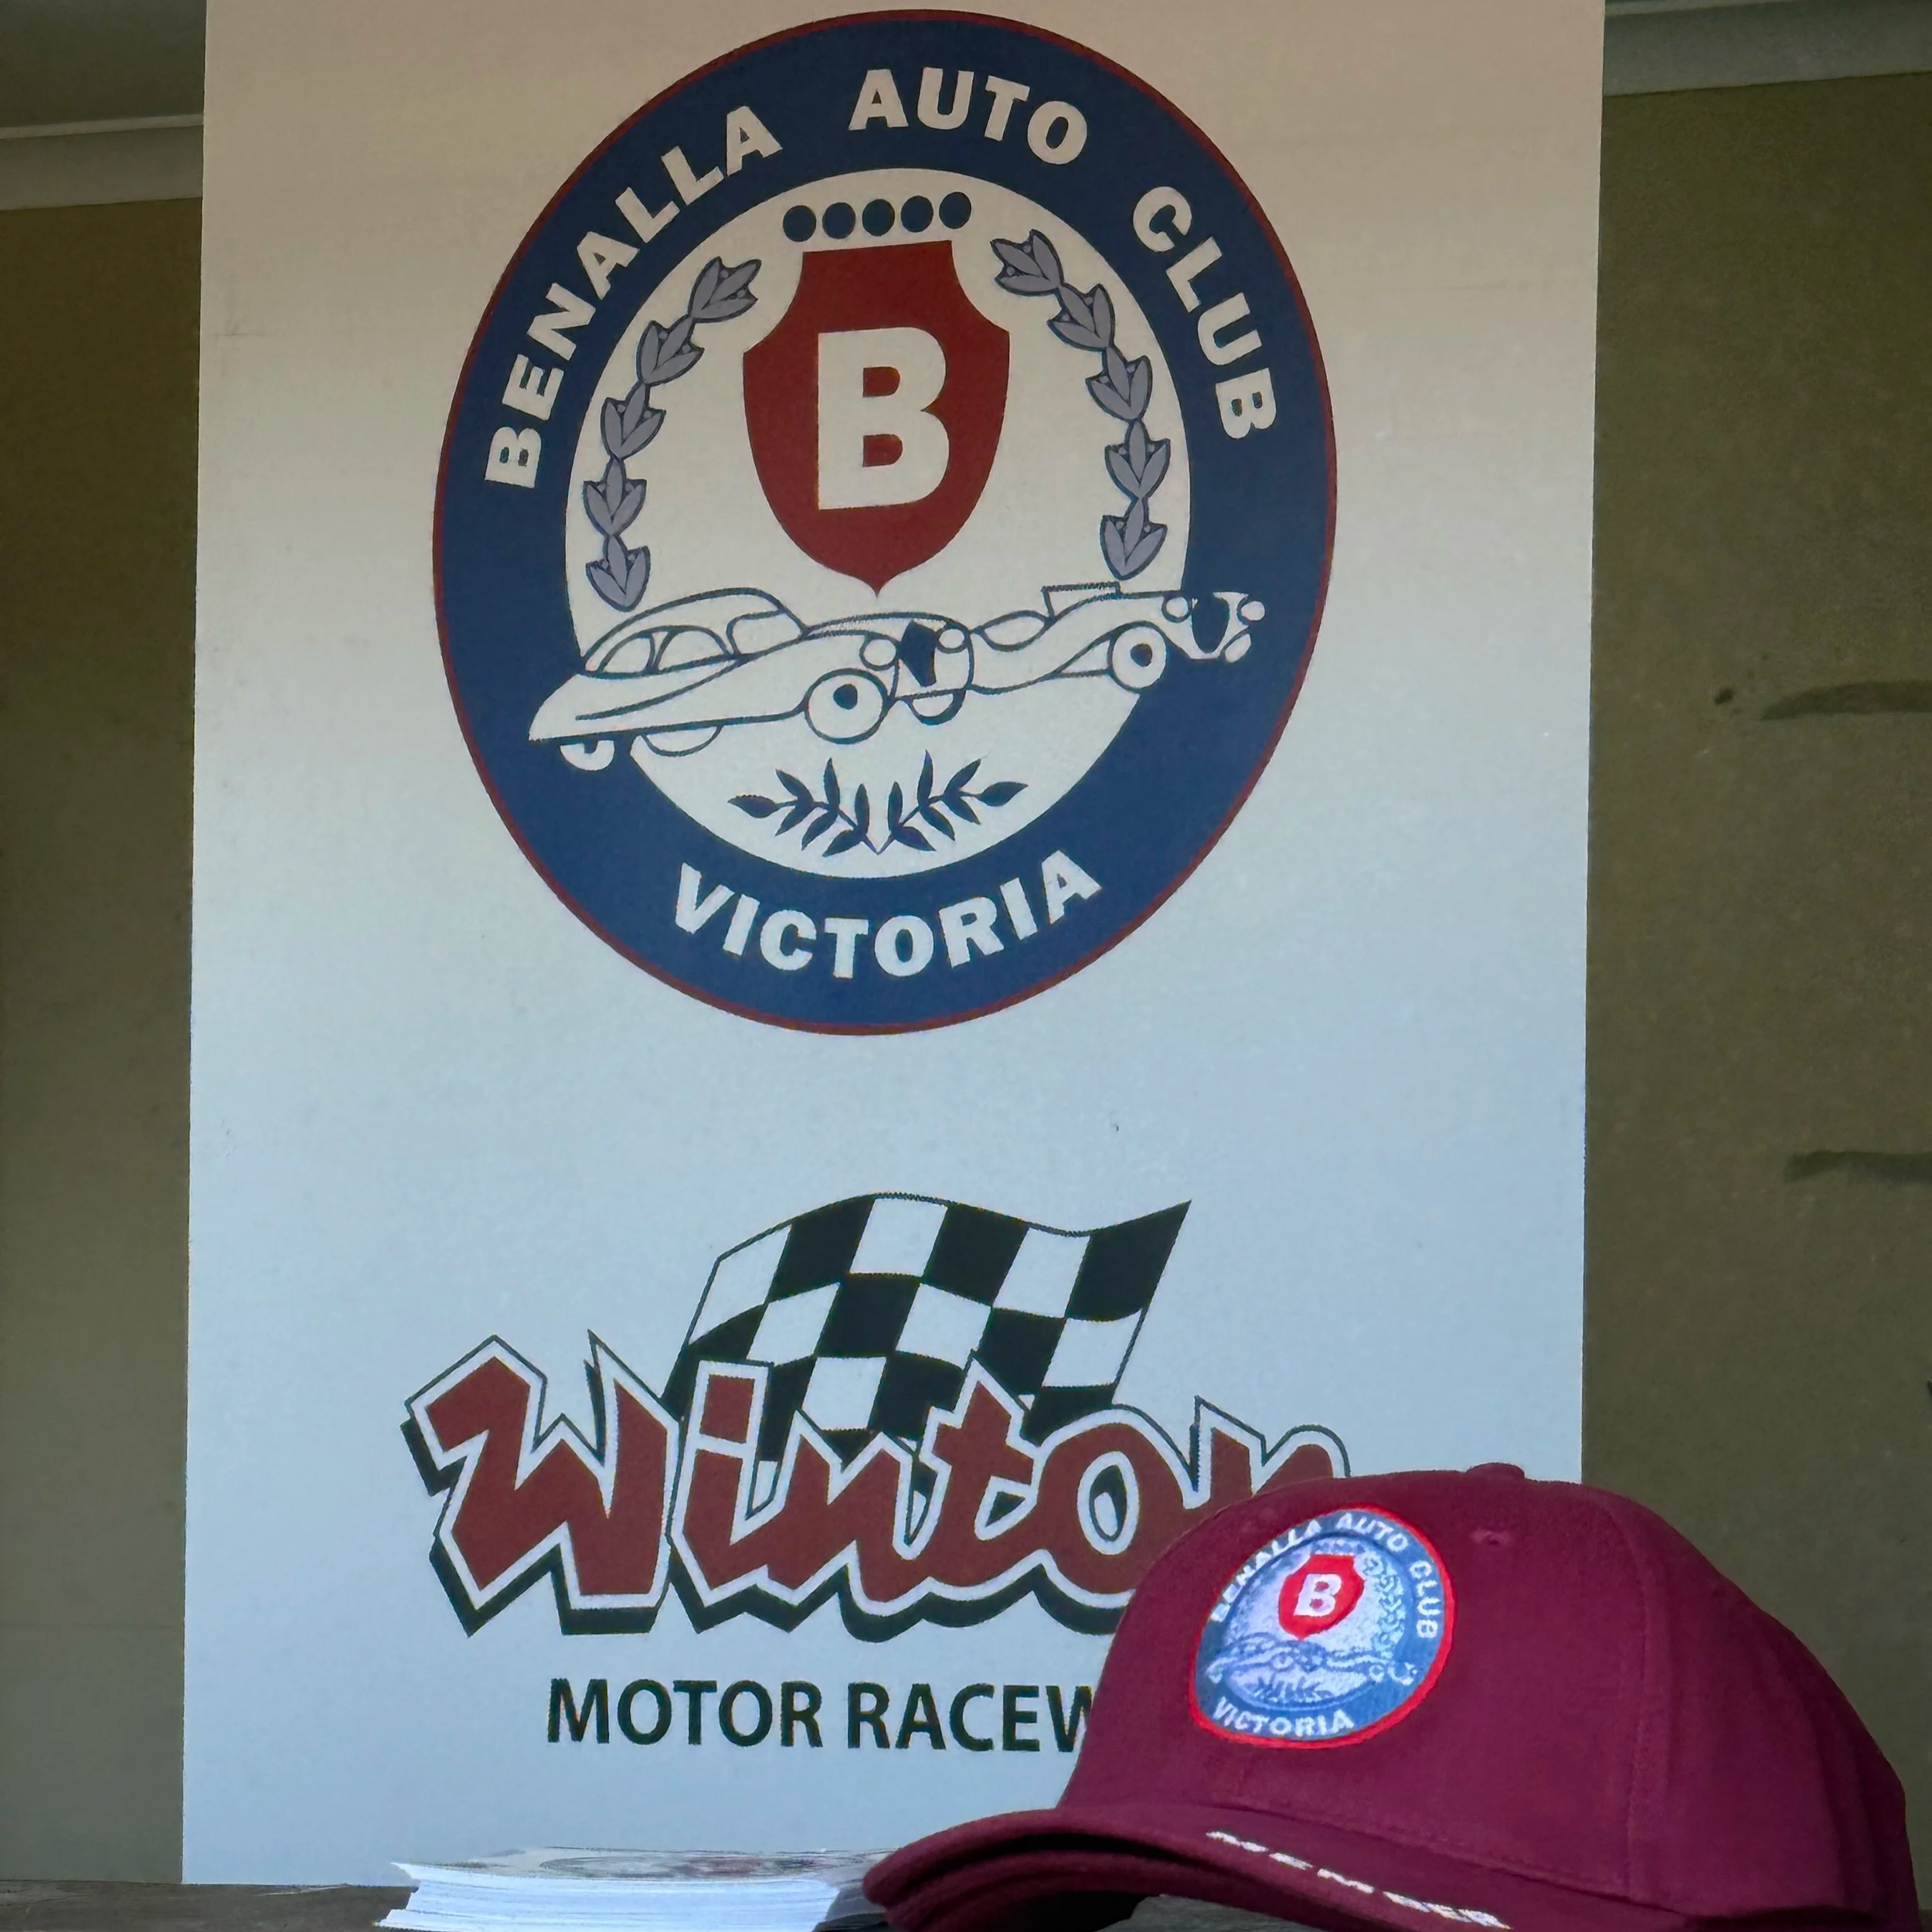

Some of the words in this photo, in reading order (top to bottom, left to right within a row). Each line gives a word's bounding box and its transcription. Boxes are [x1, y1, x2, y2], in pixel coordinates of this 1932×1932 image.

[484, 104, 783, 489] BENALLA
[848, 66, 1088, 165] AUTO
[1131, 185, 1277, 440] CLUB
[816, 325, 951, 511] B
[675, 849, 1102, 979] VICTORIA
[1294, 1573, 1343, 1617] B
[1335, 1512, 1409, 1552] AUTO
[1409, 1560, 1444, 1639] CLUB
[547, 1678, 822, 1745] MOTOR
[1211, 1696, 1355, 1738] VICTORIA
